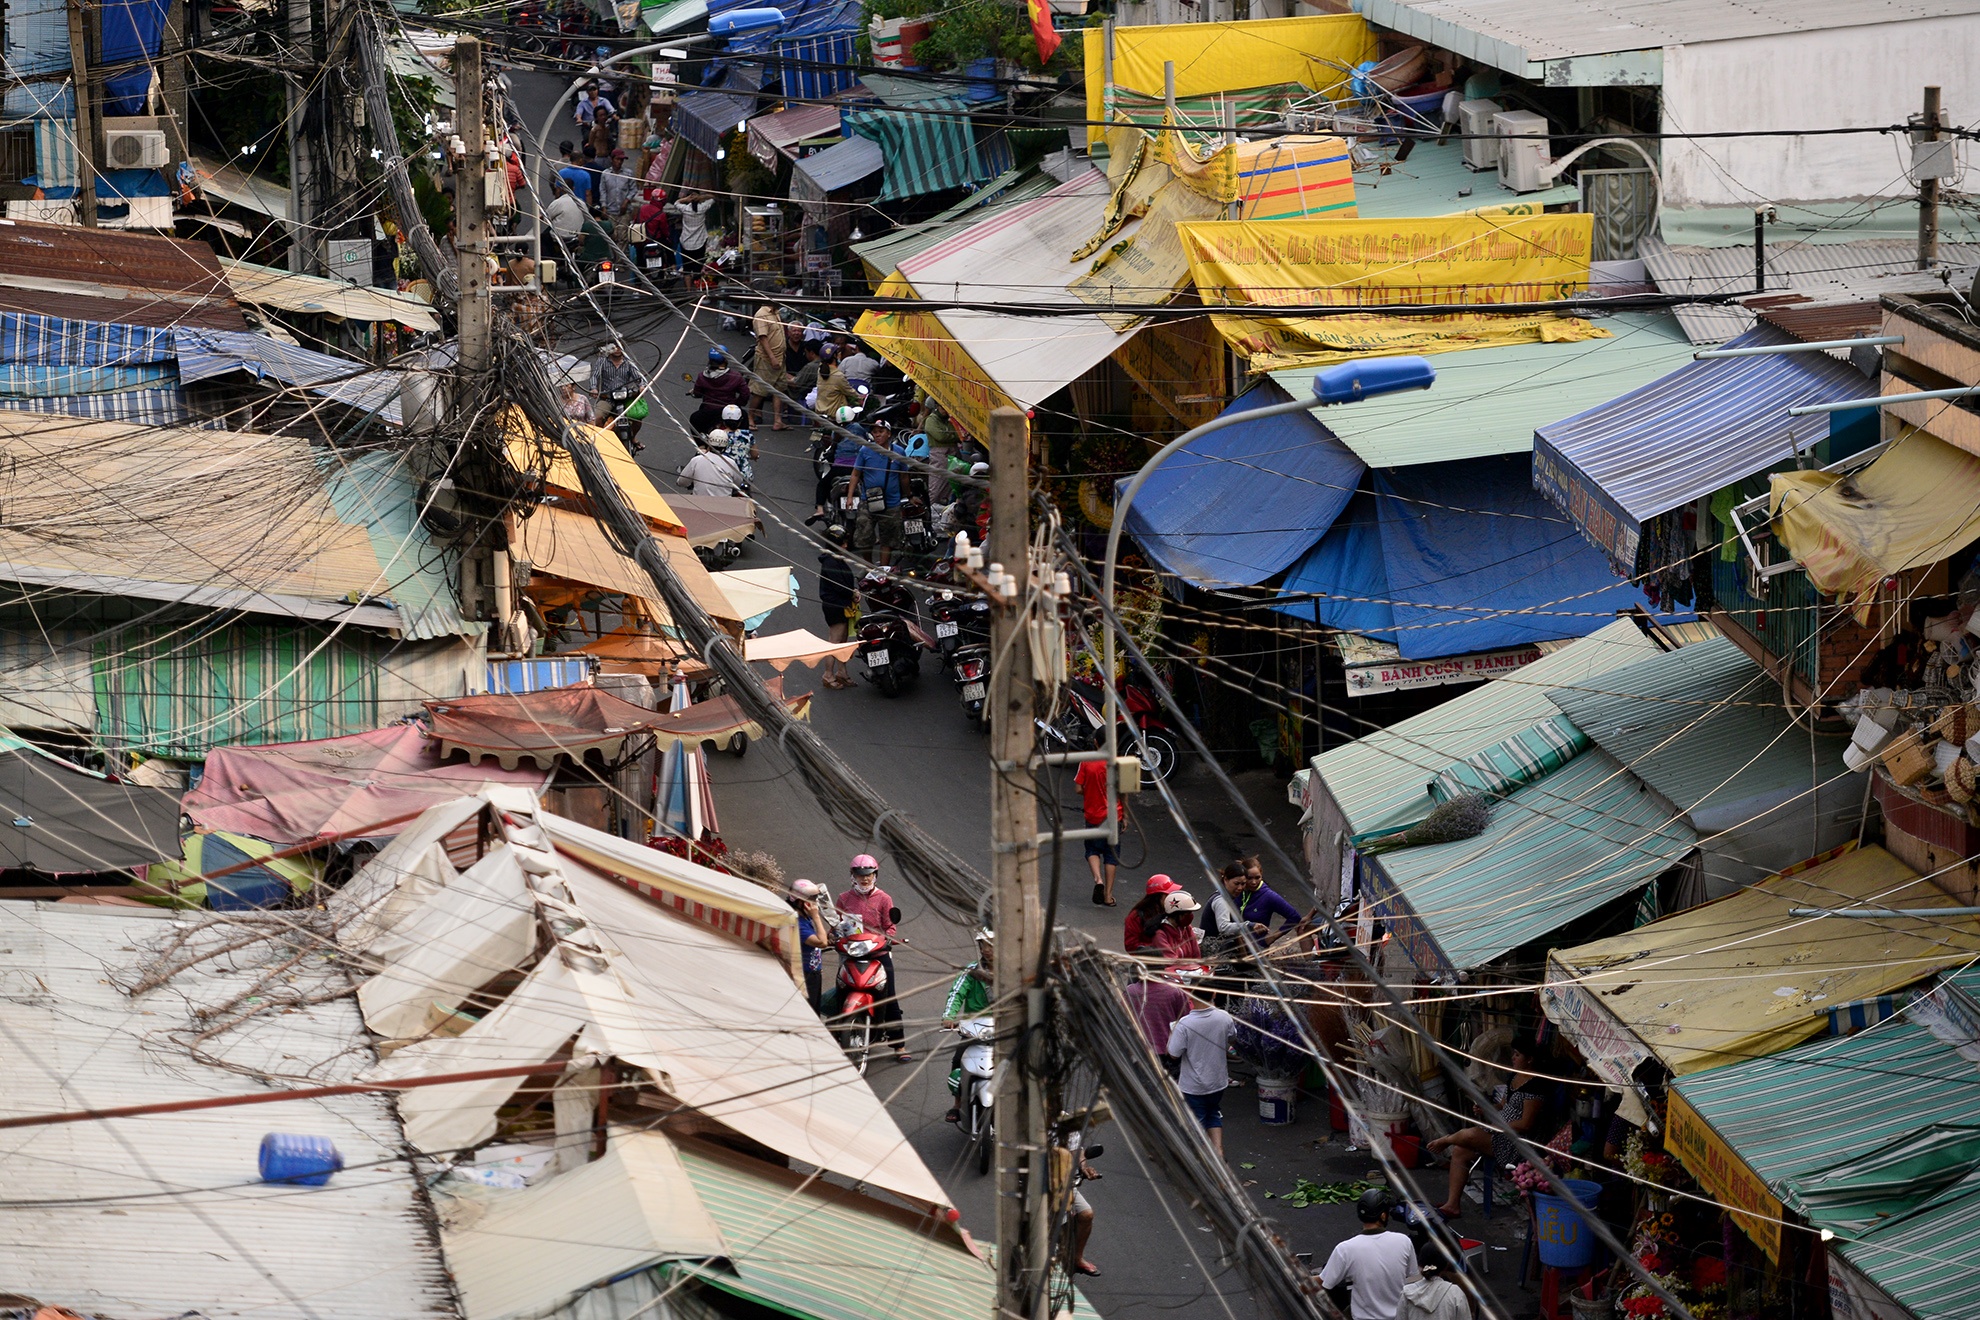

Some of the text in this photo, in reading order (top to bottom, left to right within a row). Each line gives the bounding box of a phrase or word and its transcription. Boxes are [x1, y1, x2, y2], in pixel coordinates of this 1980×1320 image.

[1287, 234, 1312, 266] Chúc
[1362, 233, 1390, 271] Phát
[1411, 232, 1438, 270] Phát
[1484, 230, 1519, 267] Khang
[1559, 227, 1585, 264] Phúc
[1380, 666, 1421, 683] BÁNH
[1424, 658, 1463, 677] CUỐN
[1474, 655, 1515, 671] BÁNH
[1517, 650, 1542, 666] ƯỚ
[1708, 1144, 1729, 1182] MAI
